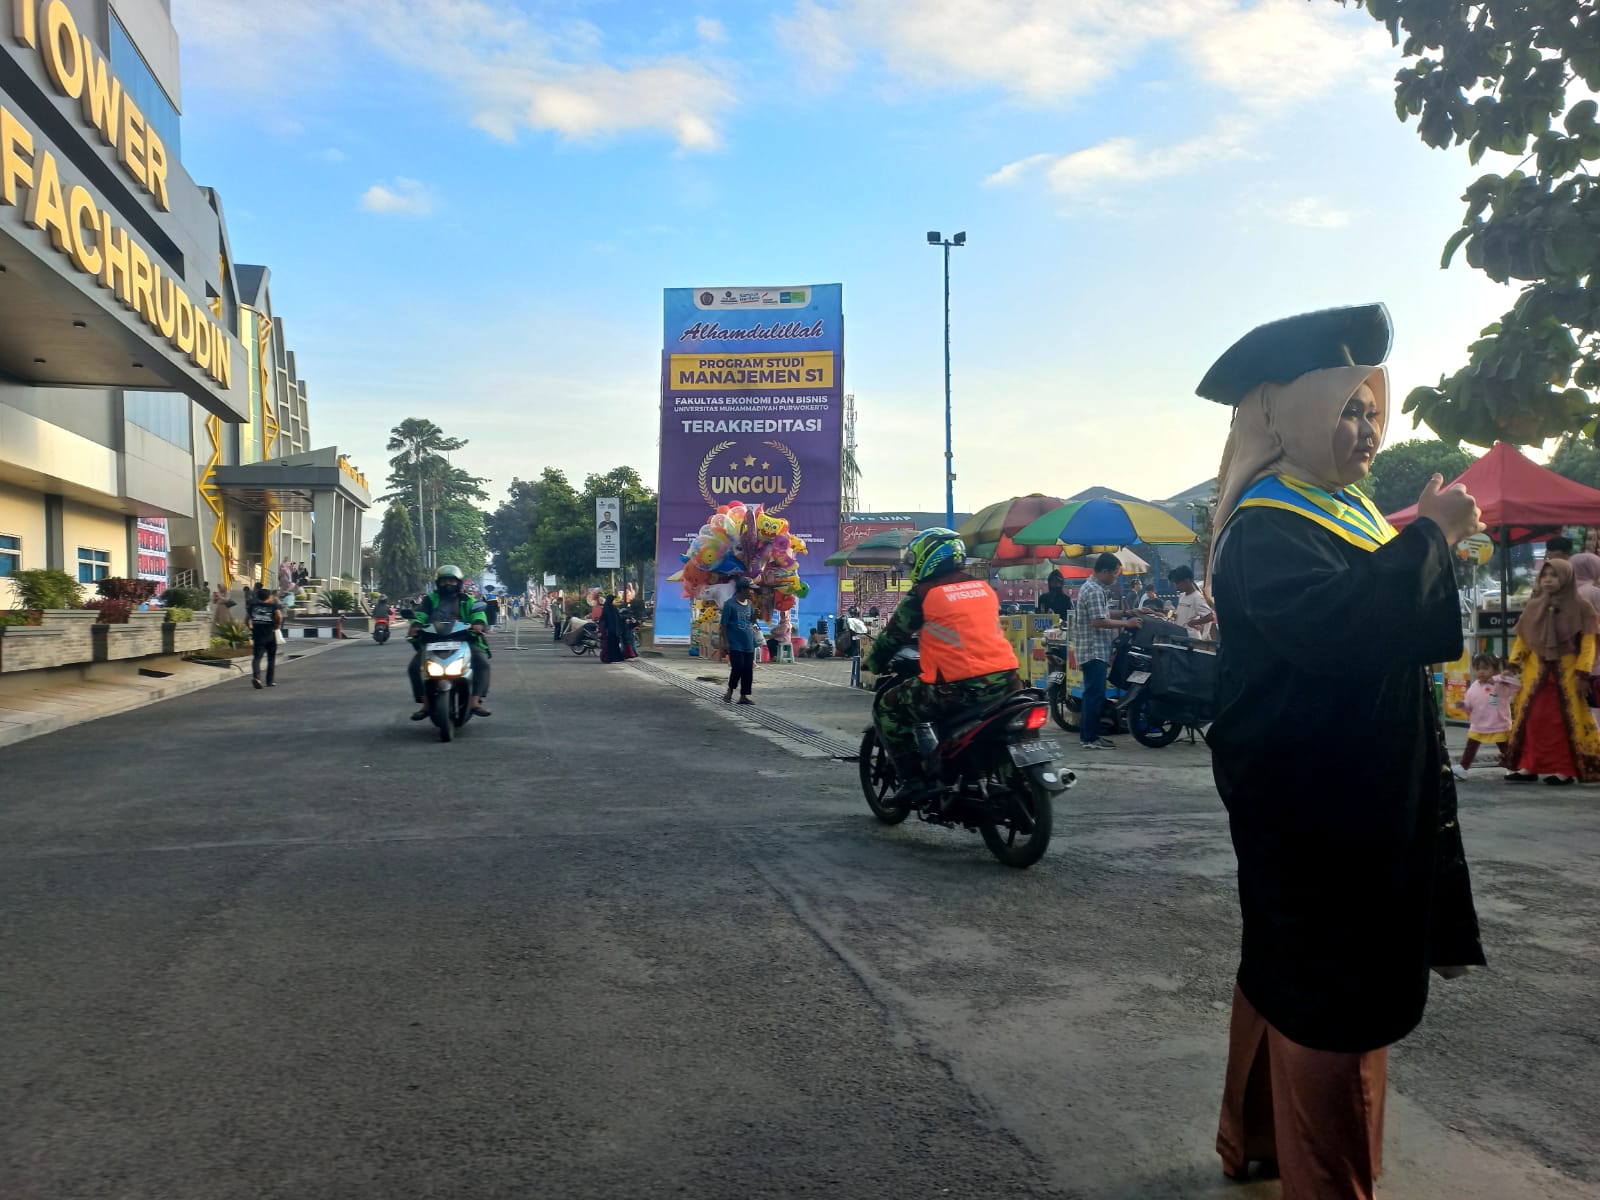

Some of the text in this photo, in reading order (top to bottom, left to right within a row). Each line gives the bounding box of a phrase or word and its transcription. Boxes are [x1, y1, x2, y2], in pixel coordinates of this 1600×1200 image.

[0, 104, 232, 391] FACHRUDDIN
[680, 319, 824, 342] Alhamdulillah
[699, 357, 805, 369] PROGRAM STUDI
[679, 368, 824, 384] MANAJEMEN S1
[675, 395, 828, 405] FAKULTAS EKONOMI DAN BISNIS
[779, 404, 829, 412] PURWOKERTO
[681, 418, 822, 433] TERAKREDITASI
[711, 475, 788, 494] UNGGUL
[945, 589, 989, 601] WISUDA
[1490, 616, 1516, 625] Orer
